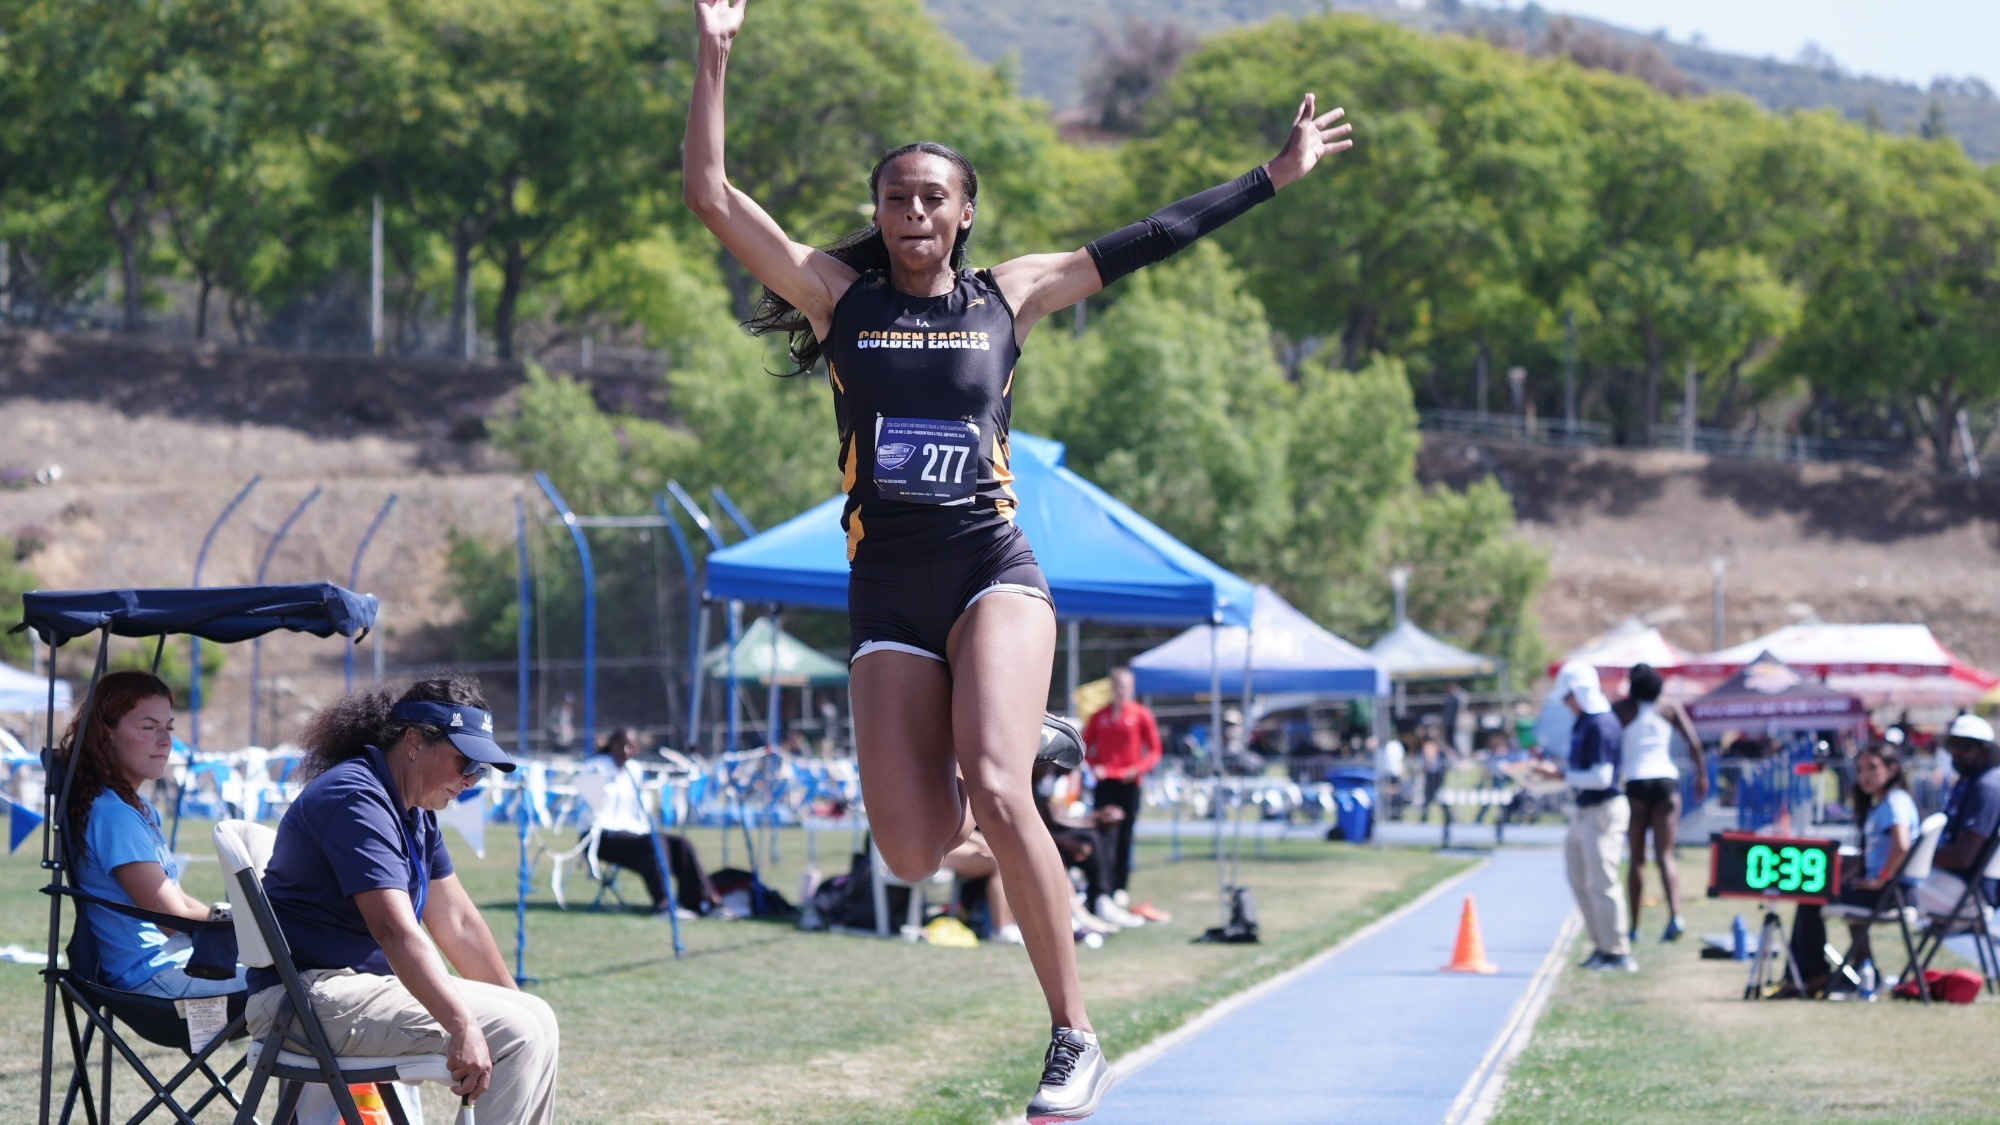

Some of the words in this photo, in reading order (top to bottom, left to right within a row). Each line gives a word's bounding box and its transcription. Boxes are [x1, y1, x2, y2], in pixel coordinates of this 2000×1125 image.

[916, 318, 930, 328] LA
[857, 330, 924, 349] GOLDEN
[927, 331, 990, 351] EAGLES
[920, 443, 970, 484] 277
[1746, 845, 1826, 892] 0:39
